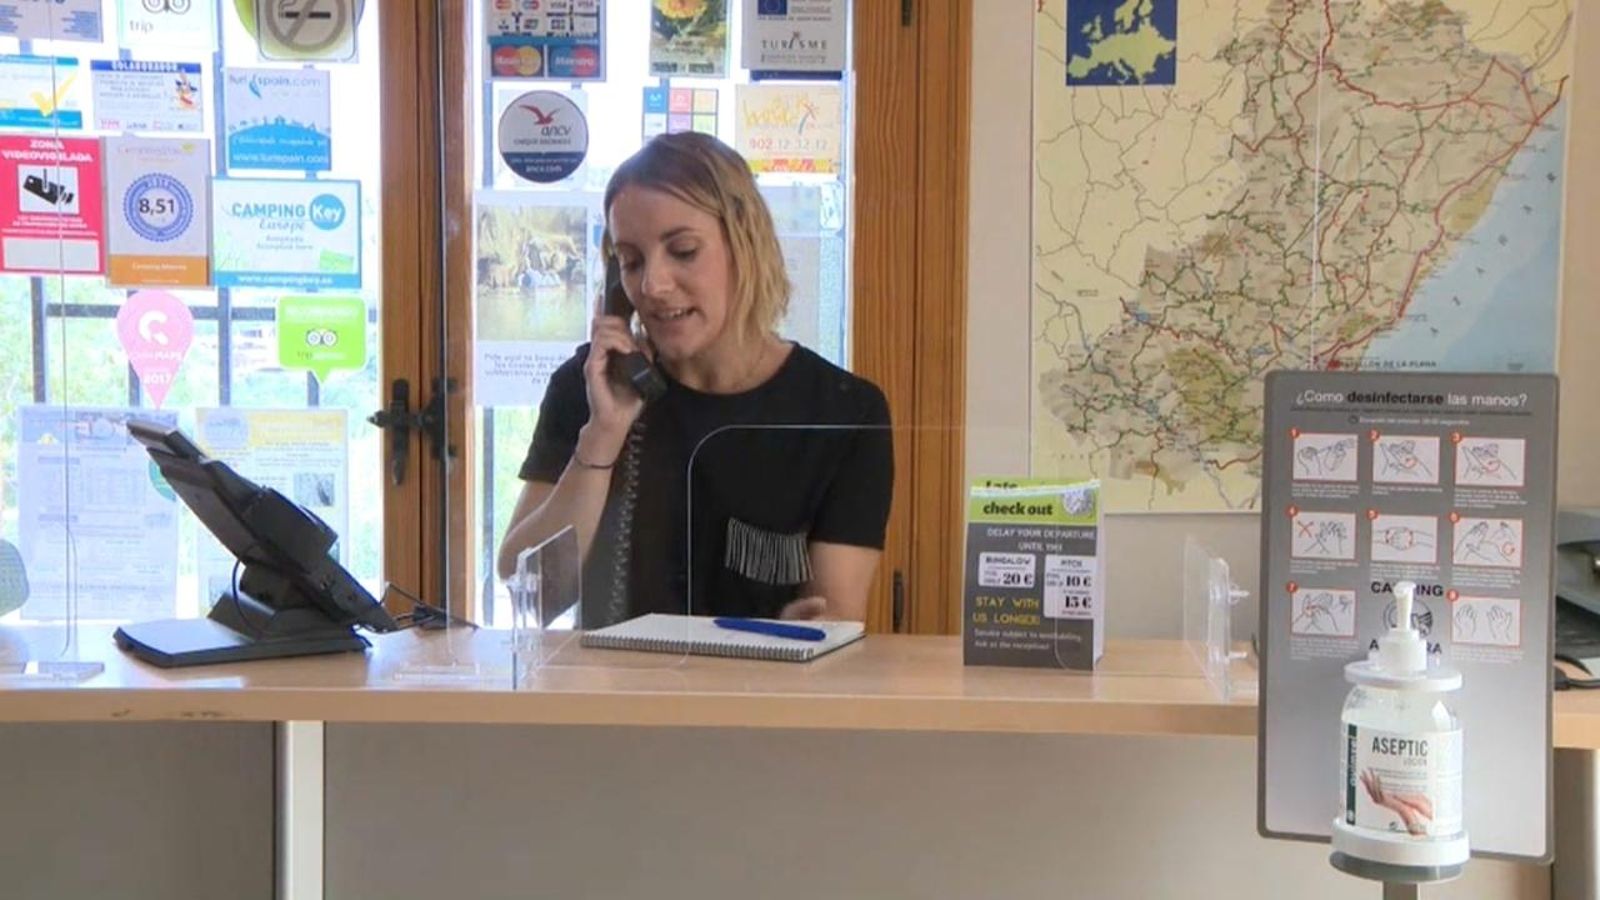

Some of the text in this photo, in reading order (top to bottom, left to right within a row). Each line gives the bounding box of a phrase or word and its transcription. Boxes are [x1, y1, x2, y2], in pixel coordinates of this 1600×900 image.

[541, 125, 571, 137] ancv
[30, 140, 65, 150] ZONA
[2, 150, 93, 162] VIDEOVIGILADA
[138, 197, 176, 215] 8,51
[231, 202, 342, 223] CAMPING Key
[1296, 389, 1528, 408] ¿Como desinfectarse las manos?
[983, 502, 1053, 515] check out
[986, 528, 1096, 539] DELAY YOUR DEPARTURE
[1018, 542, 1044, 551] UNTIL
[985, 556, 1031, 565] BUNGALOW
[1002, 571, 1021, 585] 20
[1024, 573, 1033, 585] €
[1066, 575, 1081, 587] 10
[1083, 576, 1092, 587] €
[1371, 581, 1444, 597] CAING
[976, 596, 1040, 609] STAY WITH
[1082, 596, 1092, 608] €
[973, 612, 987, 623] US
[1371, 737, 1428, 757] ASEPTIC
